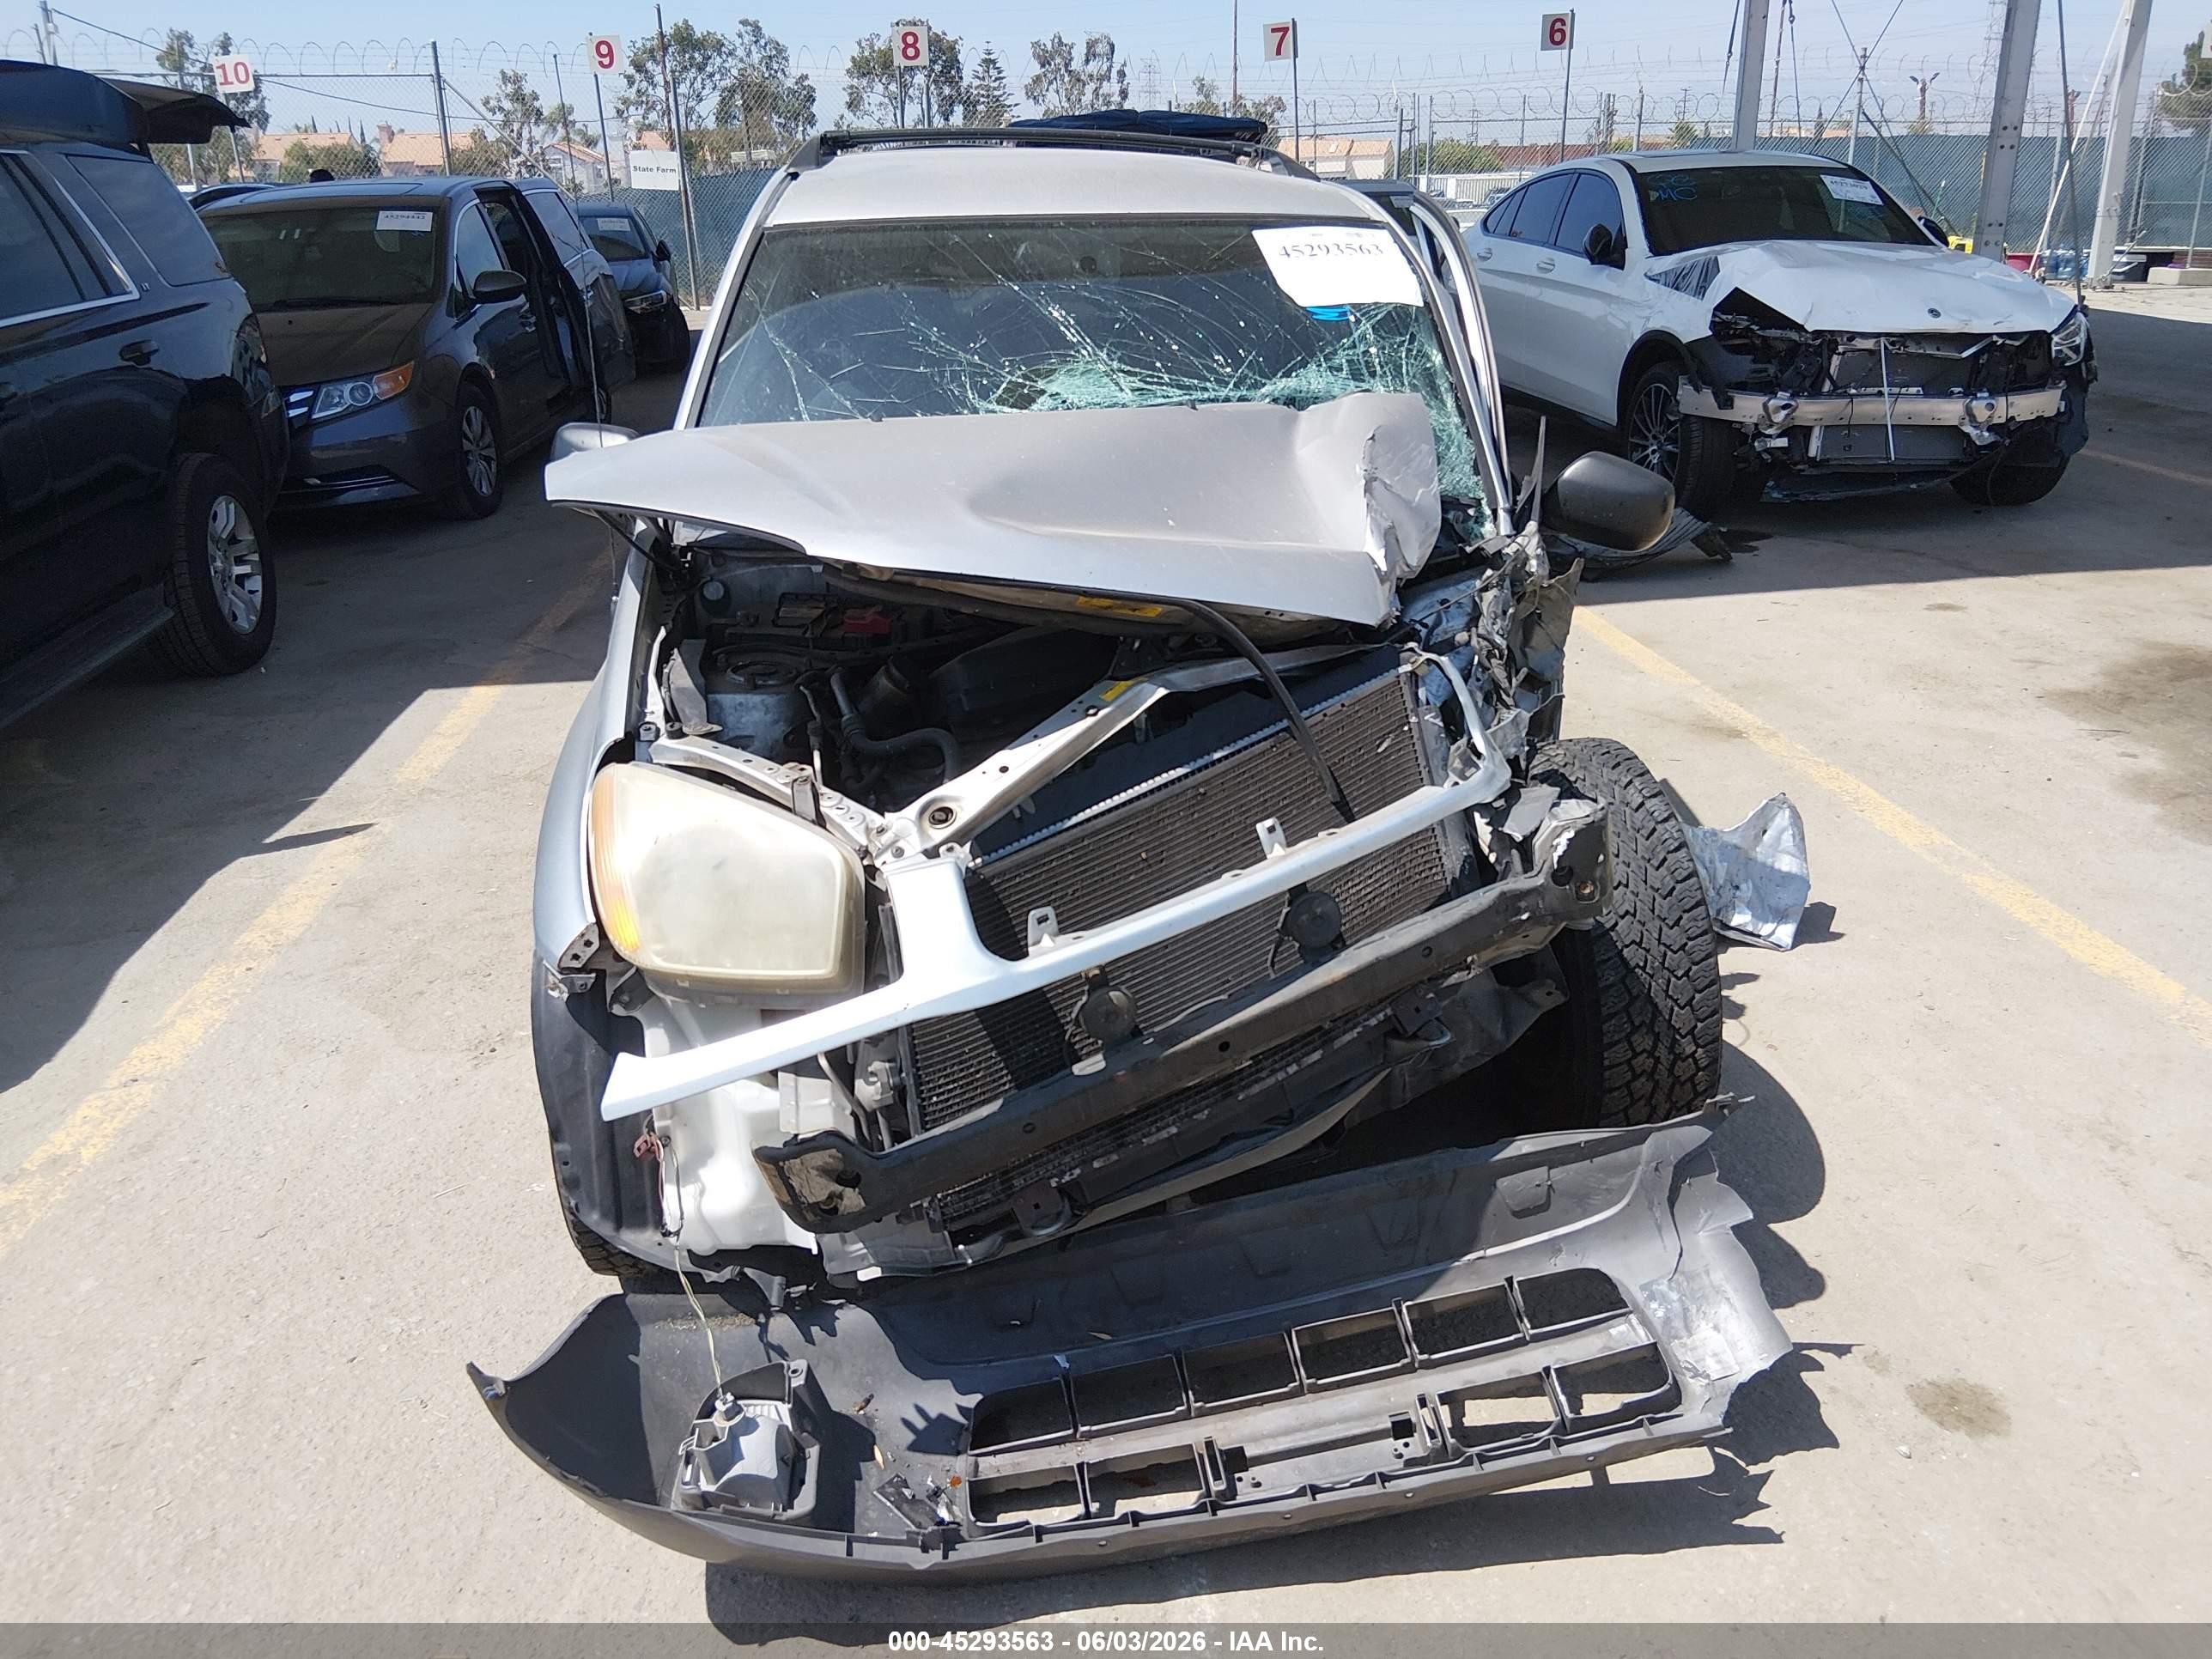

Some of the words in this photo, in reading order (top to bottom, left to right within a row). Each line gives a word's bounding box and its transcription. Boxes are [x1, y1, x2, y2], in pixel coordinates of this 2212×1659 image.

[902, 31, 921, 60] 8
[1271, 27, 1290, 56] 7
[1549, 17, 1566, 46] 6
[595, 40, 615, 69] 9
[216, 61, 250, 86] 10
[1279, 242, 1385, 258] 45293563
